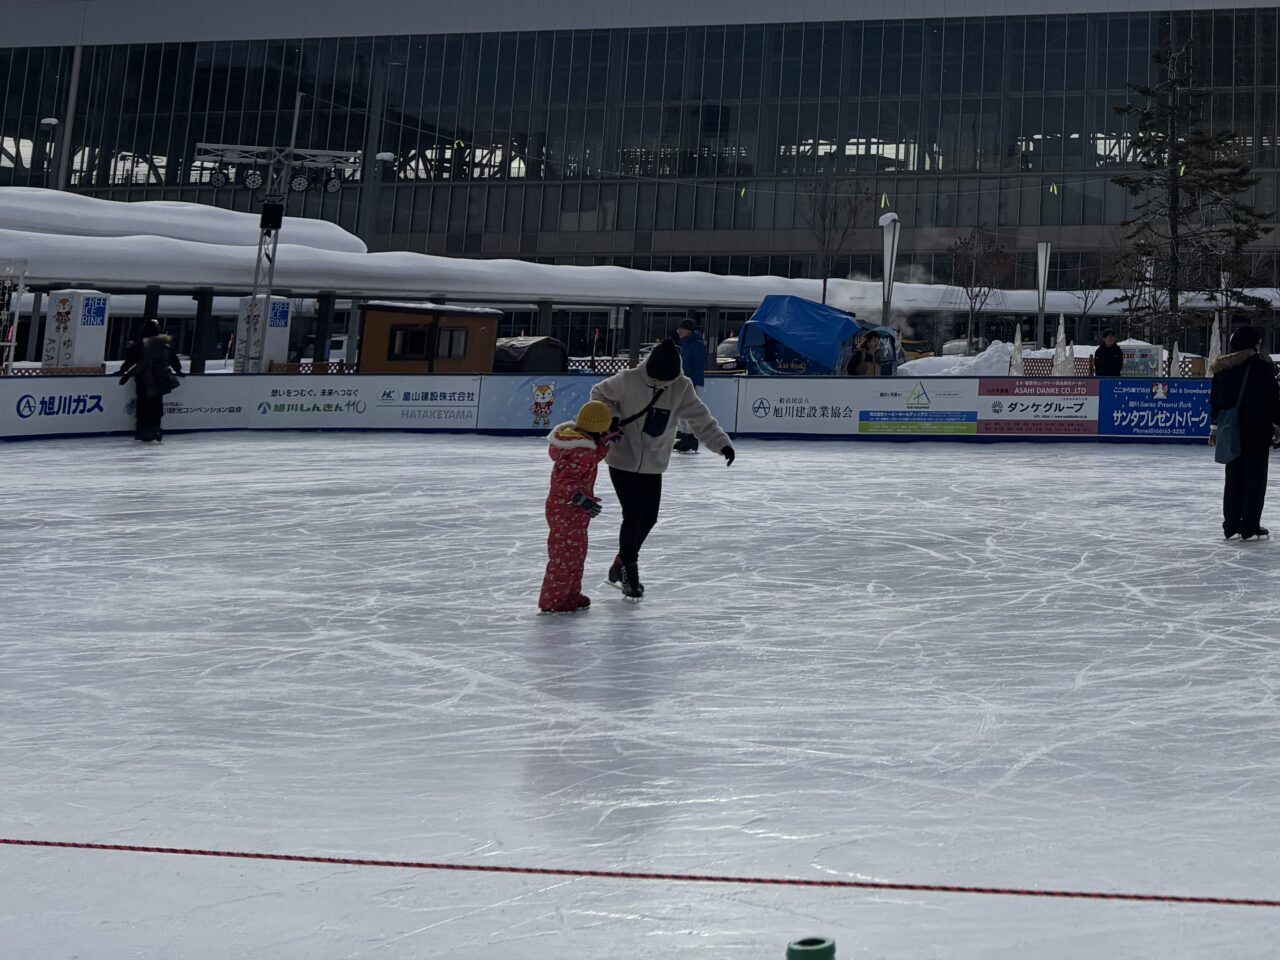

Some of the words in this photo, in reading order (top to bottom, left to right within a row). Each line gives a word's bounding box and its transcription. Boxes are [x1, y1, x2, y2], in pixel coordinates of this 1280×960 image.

[84, 297, 106, 307] FREE
[82, 307, 96, 316] ICE
[81, 316, 103, 325] RINK
[39, 395, 104, 416] 旭川ガス
[273, 403, 344, 413] 旭川しんきん
[1007, 402, 1084, 413] ダンケグループ
[401, 409, 473, 420] HATAKEYAMA
[773, 405, 853, 418] 旭川建設業協会
[1113, 410, 1208, 427] サンタプレゼントパーク
